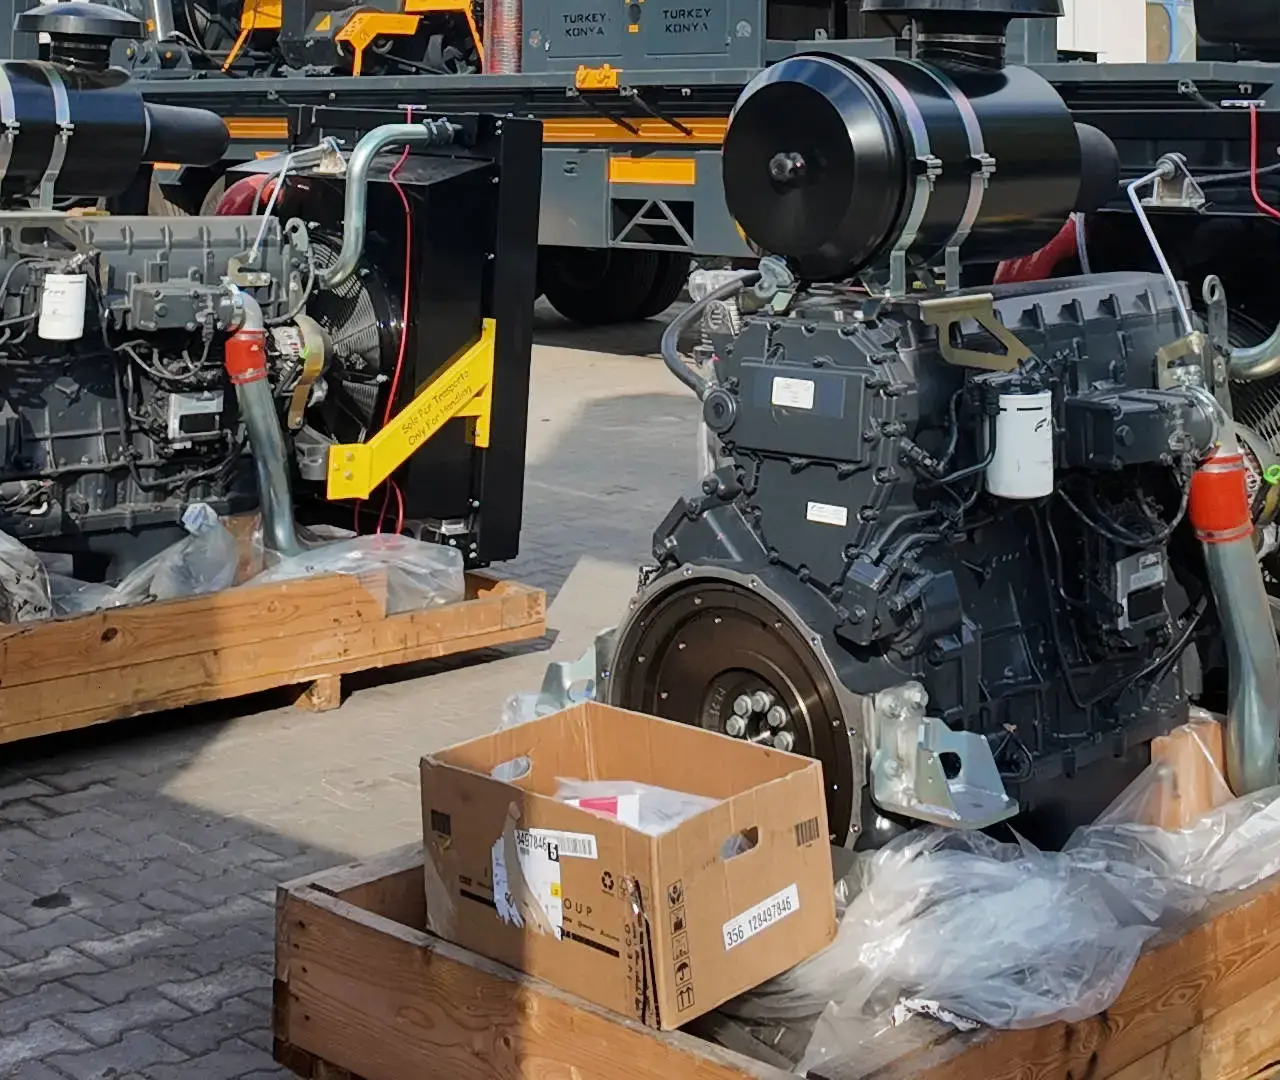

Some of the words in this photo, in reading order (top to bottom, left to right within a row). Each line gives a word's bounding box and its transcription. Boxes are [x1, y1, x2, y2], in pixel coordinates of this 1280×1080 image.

[663, 8, 712, 20] TURKEY
[565, 27, 605, 37] KONYA
[665, 22, 709, 34] KONYA
[726, 924, 744, 946] 356
[748, 896, 791, 932] 128497846
